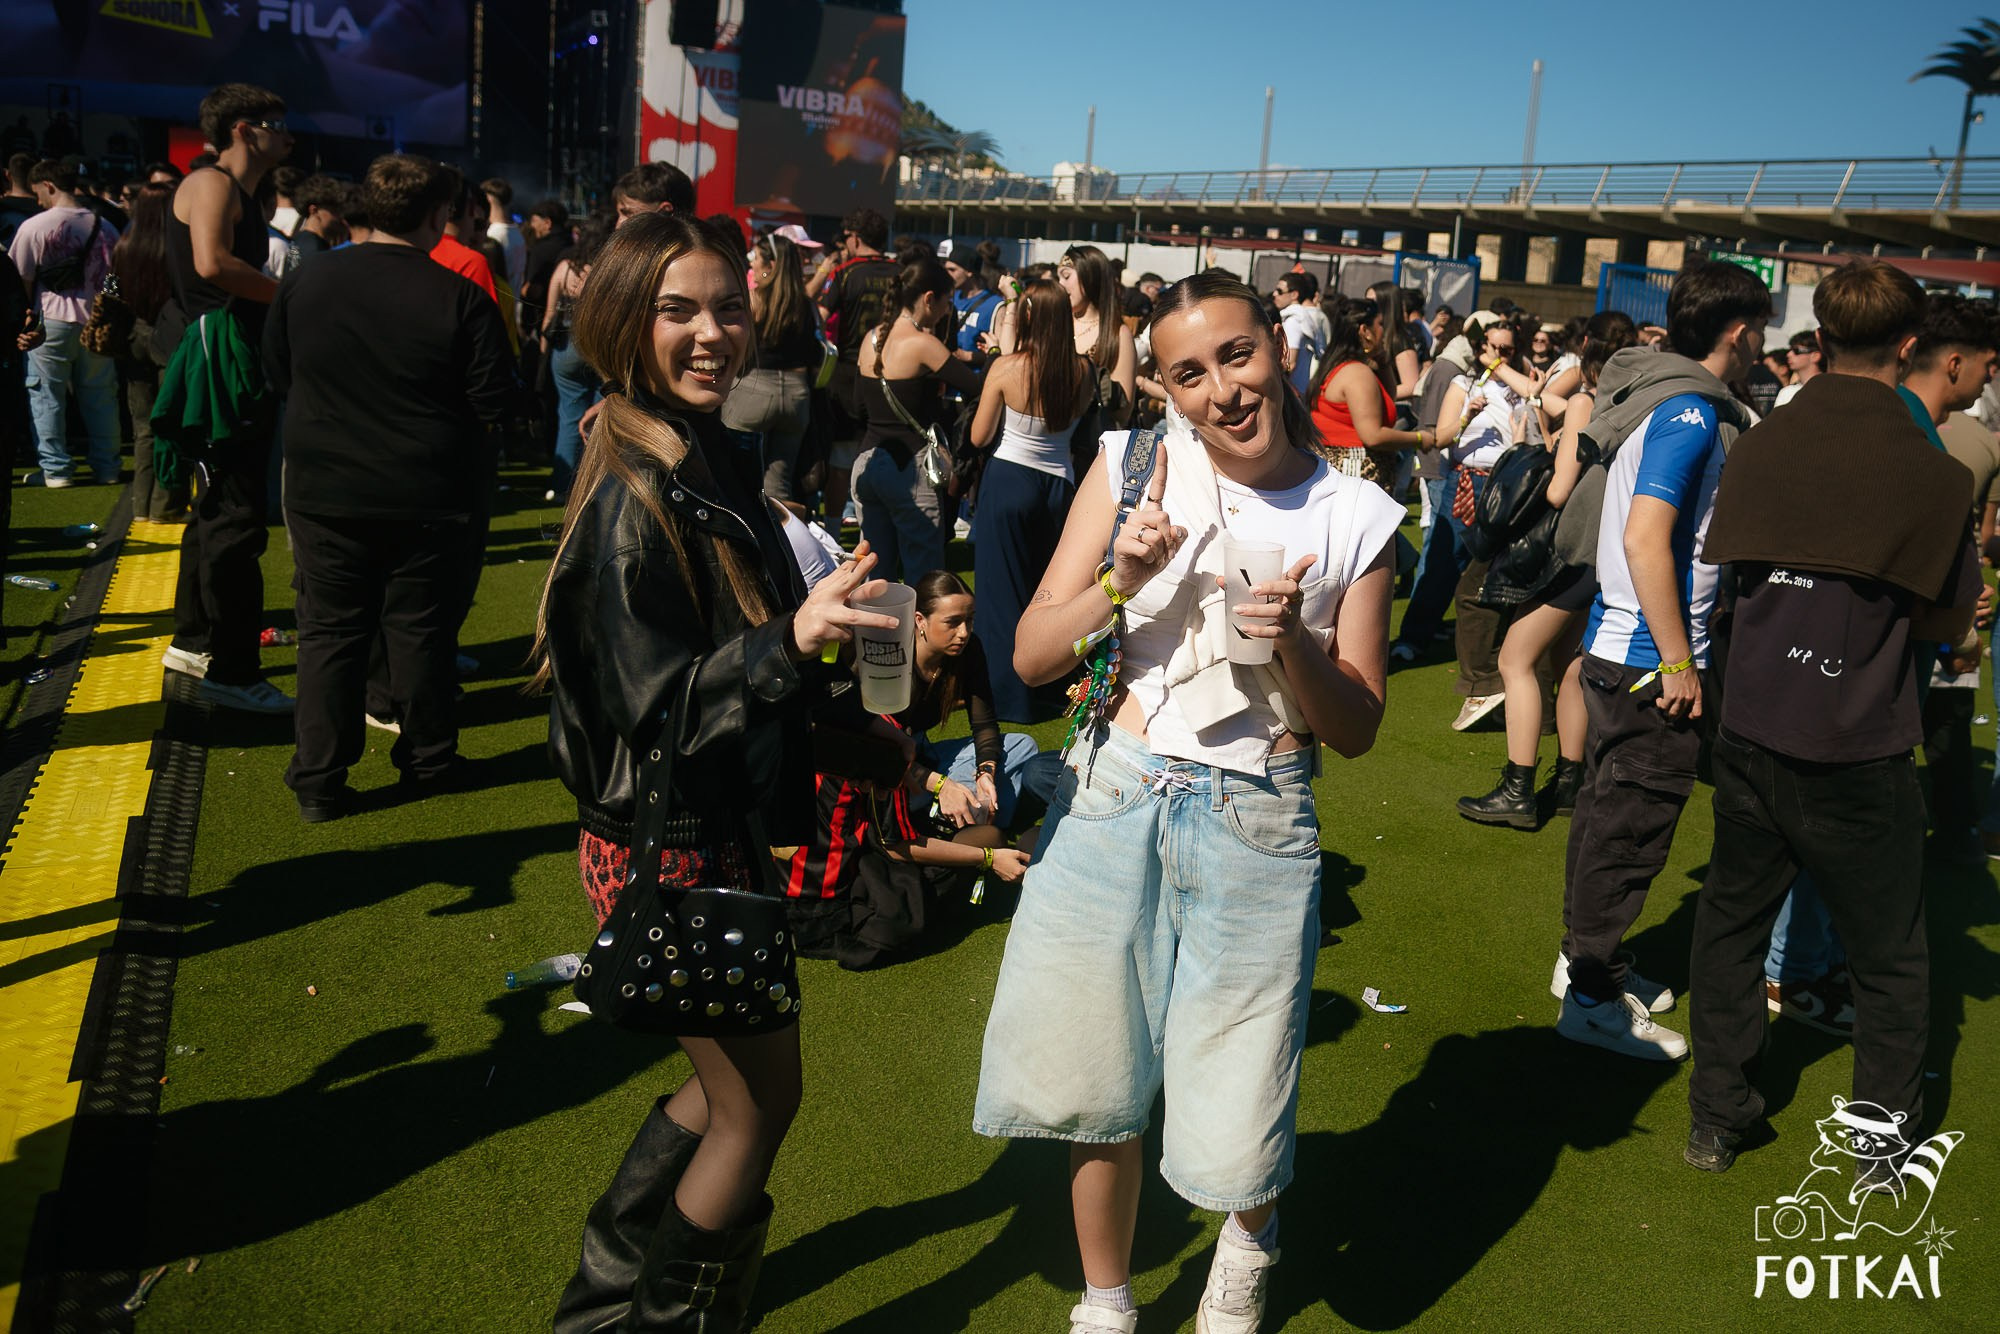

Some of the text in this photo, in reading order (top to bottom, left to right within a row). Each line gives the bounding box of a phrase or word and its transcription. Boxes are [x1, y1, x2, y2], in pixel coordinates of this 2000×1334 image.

[258, 0, 363, 40] FILA
[777, 85, 865, 117] VIBRA
[1793, 576, 1814, 589] 2019
[865, 640, 897, 655] COSTA
[865, 649, 903, 665] SONORA
